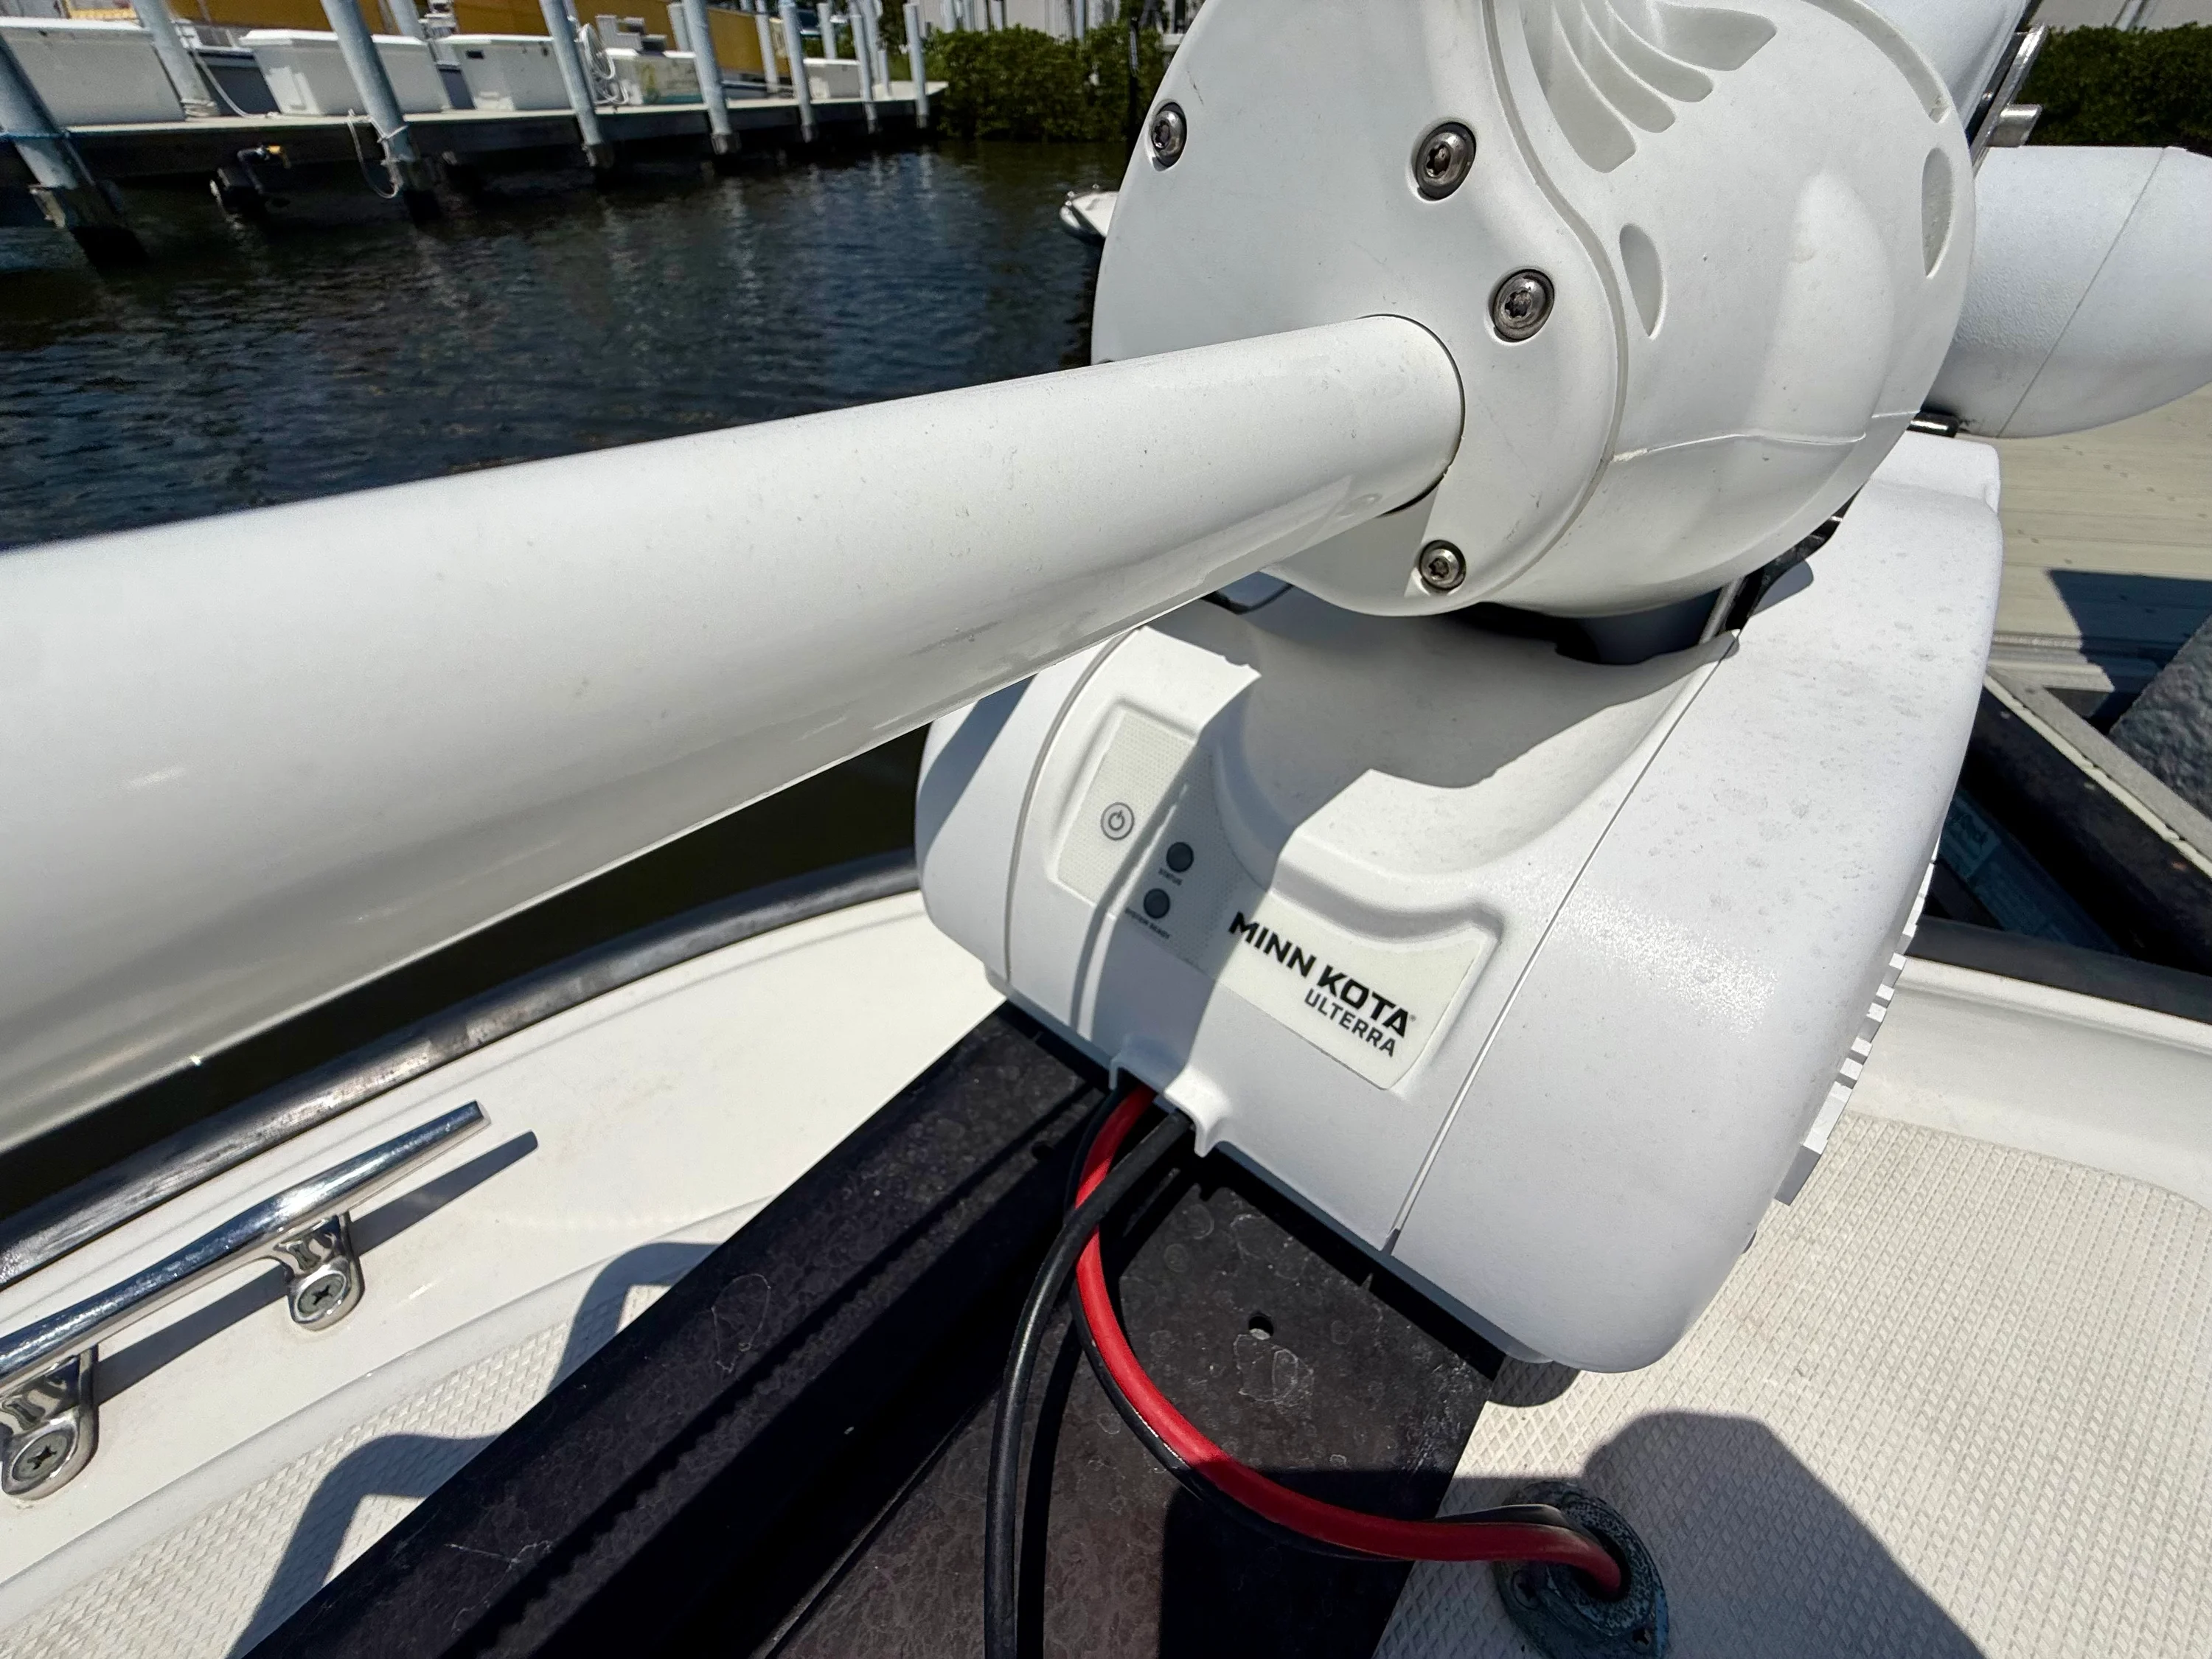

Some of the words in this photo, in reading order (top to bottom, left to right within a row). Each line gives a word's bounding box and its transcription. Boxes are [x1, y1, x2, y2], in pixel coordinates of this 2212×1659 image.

[1228, 911, 1317, 978] MINN
[1316, 964, 1409, 1038] KOTA
[1304, 988, 1396, 1058] ULTERRA
